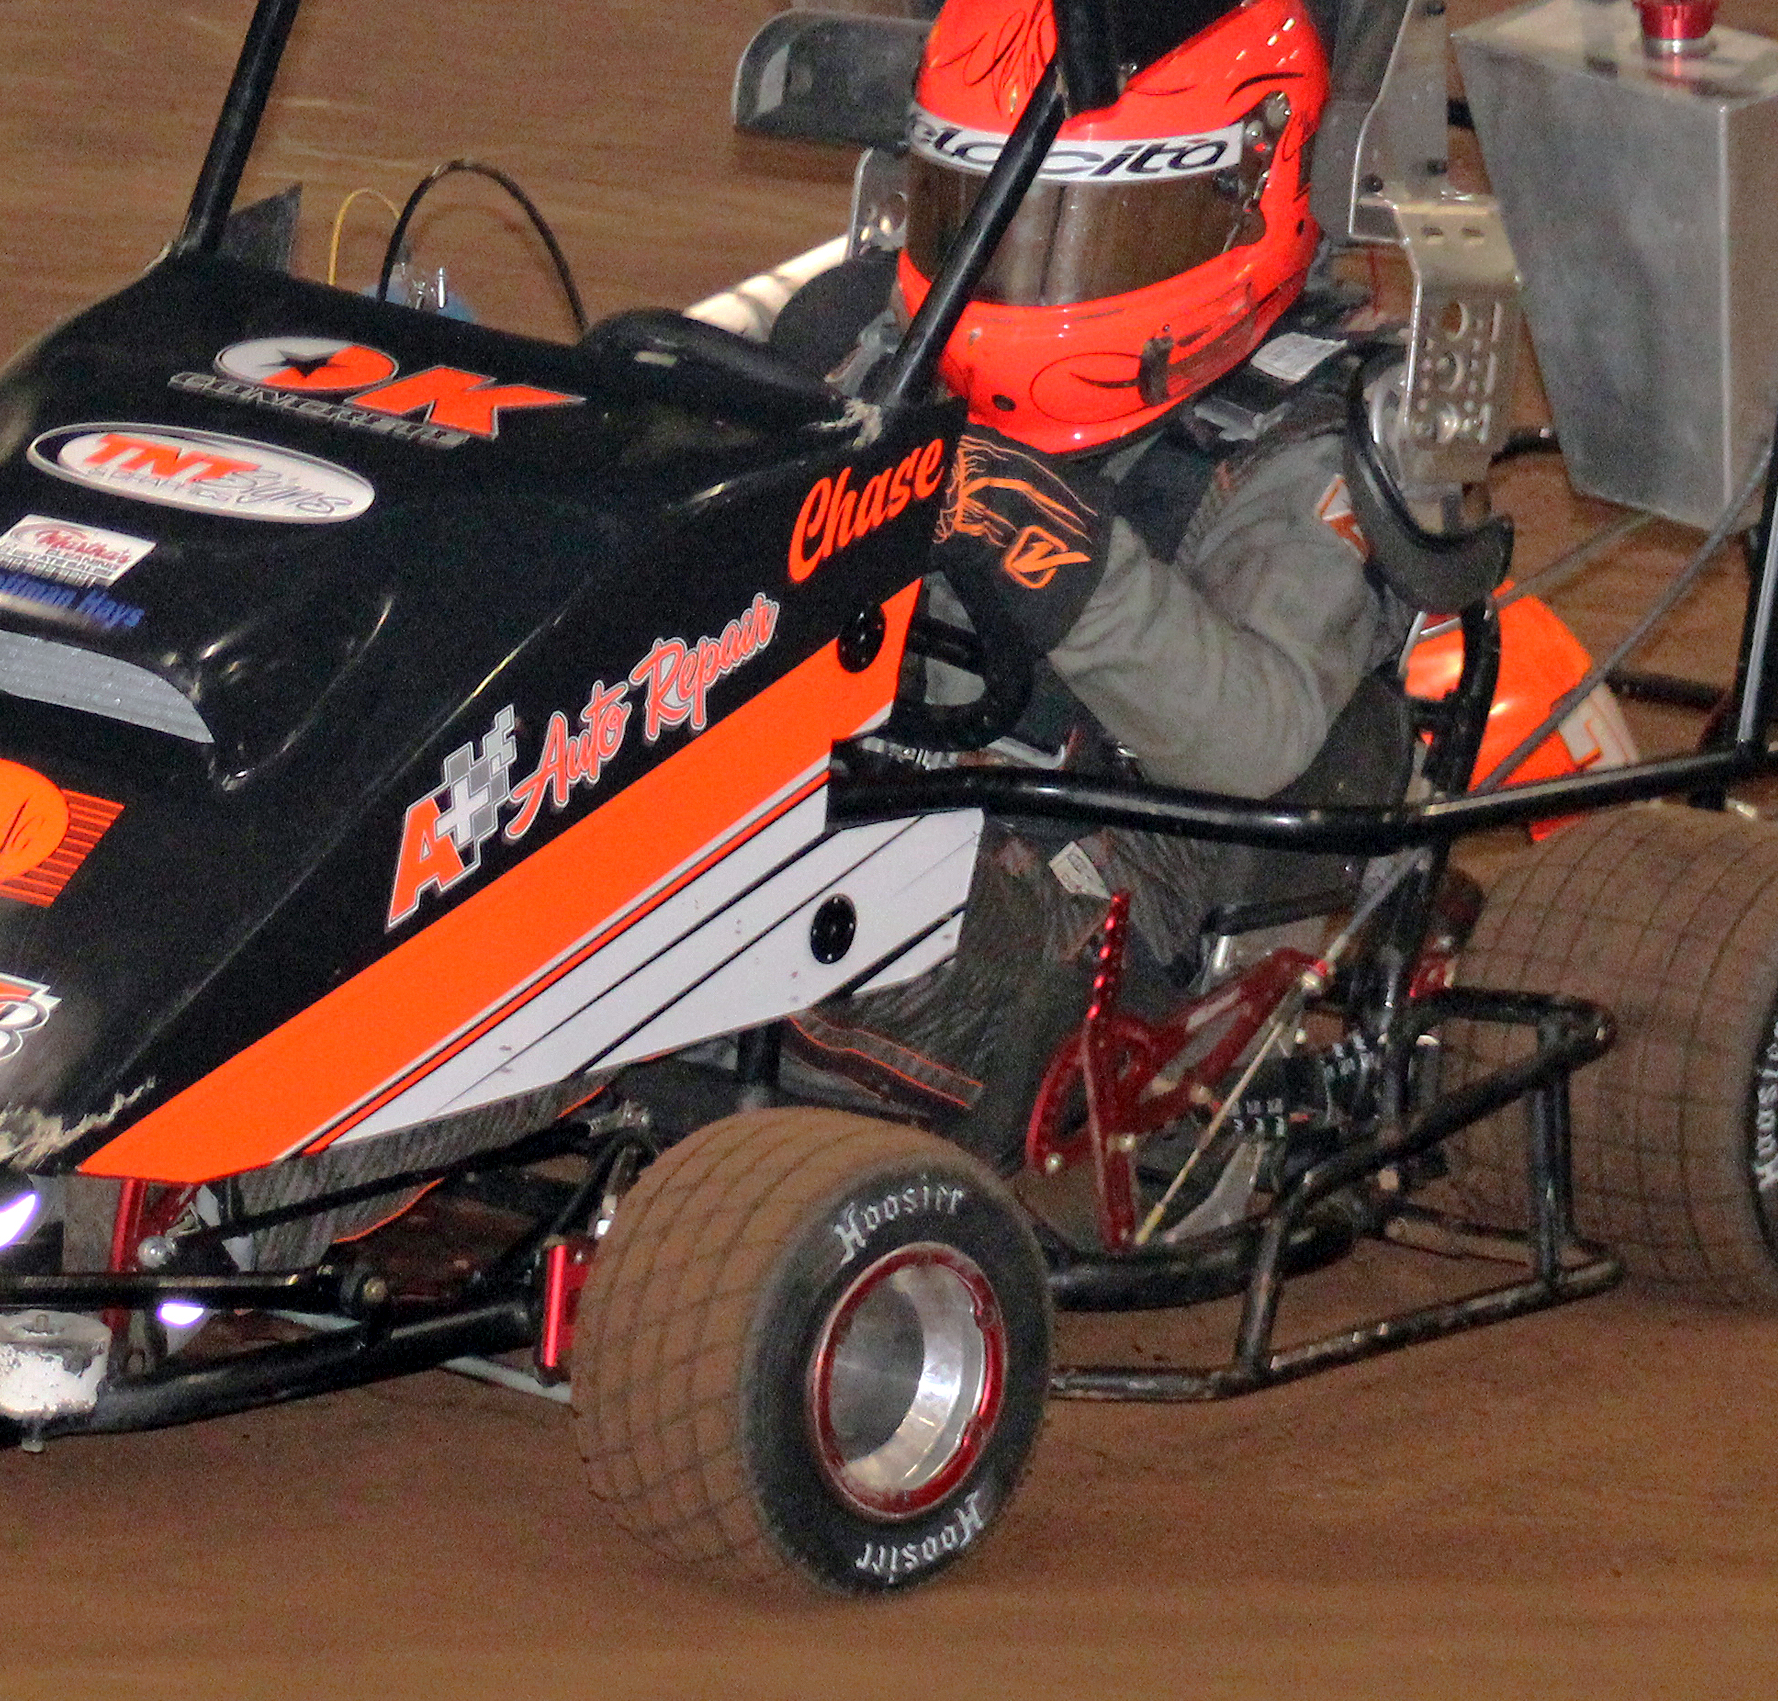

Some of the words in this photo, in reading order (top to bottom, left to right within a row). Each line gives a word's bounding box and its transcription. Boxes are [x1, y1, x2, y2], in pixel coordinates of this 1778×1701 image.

[83, 433, 262, 483] TNT
[198, 469, 354, 515] Signs
[787, 436, 945, 584] Chase
[506, 680, 631, 838] Auto
[630, 592, 779, 740] Repair
[833, 1183, 966, 1266] Hoosier
[855, 1490, 985, 1585] Hoosier
